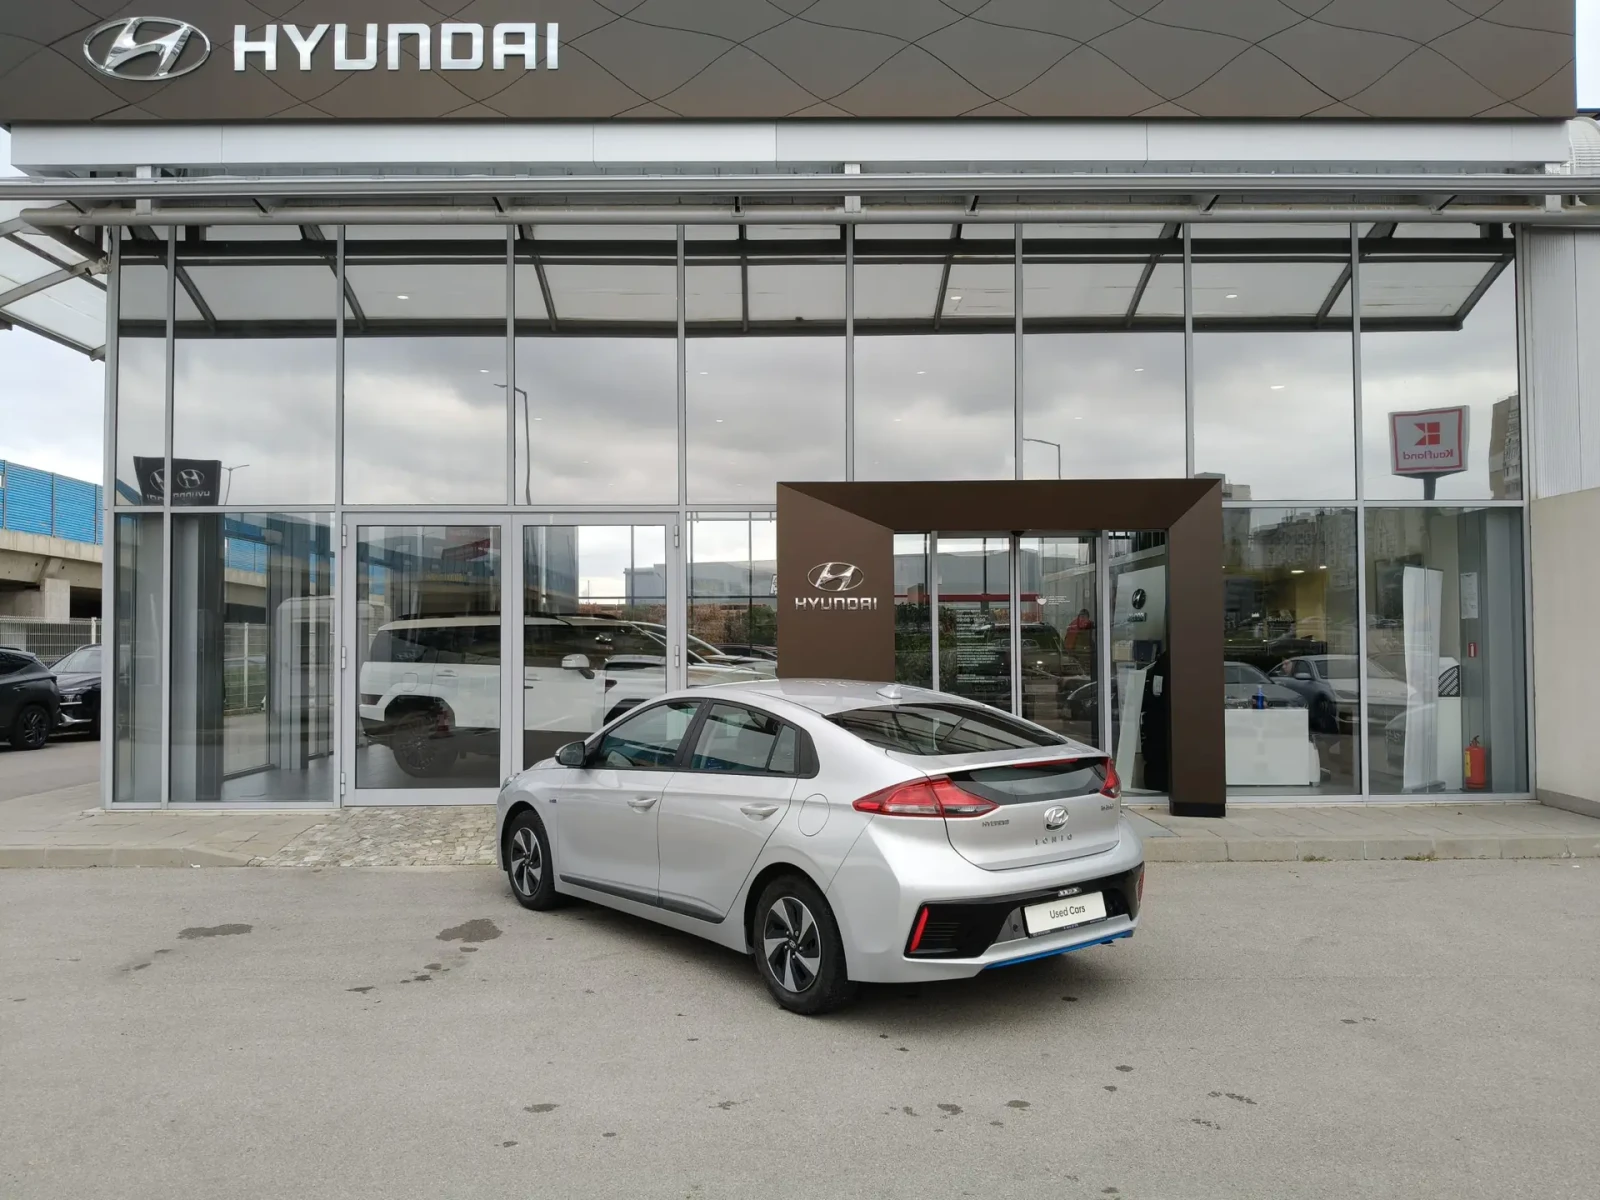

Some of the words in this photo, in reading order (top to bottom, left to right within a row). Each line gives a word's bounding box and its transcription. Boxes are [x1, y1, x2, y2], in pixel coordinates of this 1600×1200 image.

[234, 22, 559, 71] HYUNDAI
[795, 597, 878, 610] HYUNDAI
[1049, 907, 1068, 919] Used
[1069, 905, 1086, 915] Cars
